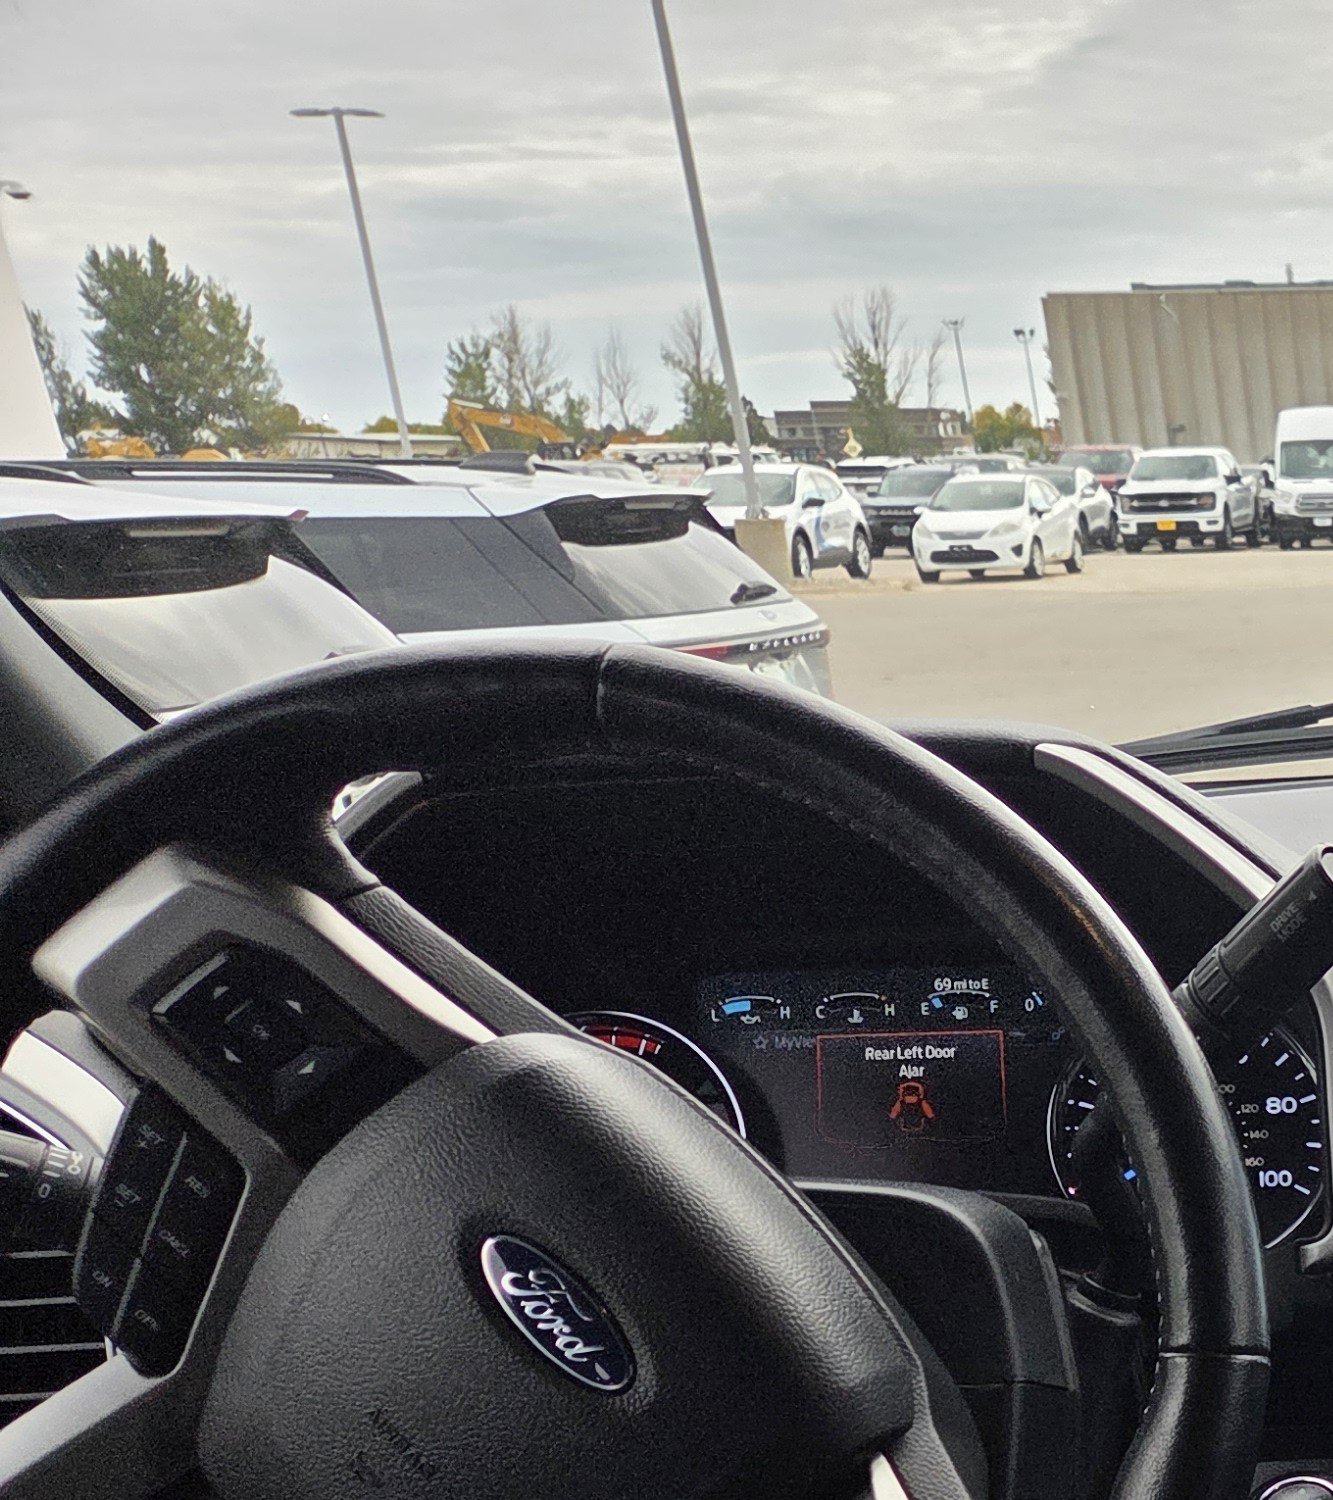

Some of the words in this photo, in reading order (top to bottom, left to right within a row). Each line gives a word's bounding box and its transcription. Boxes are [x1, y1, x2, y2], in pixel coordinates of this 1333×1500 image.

[934, 978, 953, 990] 69
[954, 978, 968, 990] mi
[982, 978, 989, 989] E
[780, 1006, 791, 1019] H
[816, 1006, 826, 1019] C
[884, 1004, 896, 1016] H
[921, 1002, 930, 1016] E
[989, 1000, 999, 1013] F
[865, 1047, 895, 1061] Rear
[896, 1046, 923, 1061] Left
[925, 1045, 956, 1060] Door
[899, 1064, 925, 1079] Ajar
[1265, 1097, 1298, 1115] 80
[1258, 1170, 1294, 1189] 100
[500, 1268, 605, 1363] Ford
